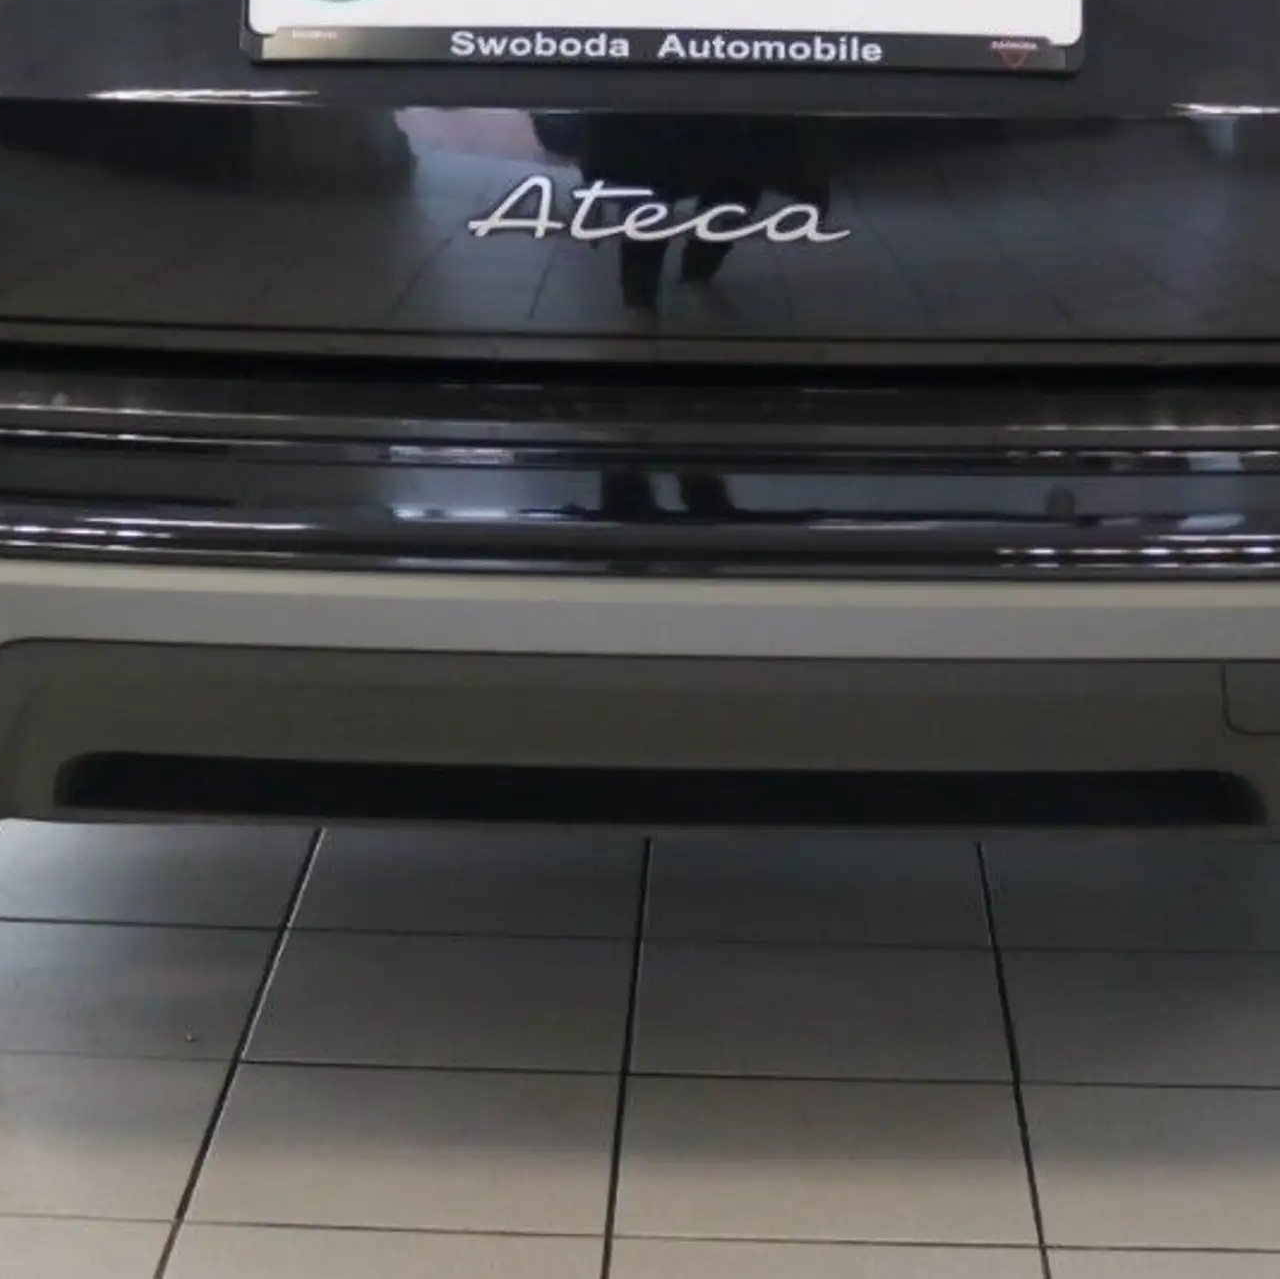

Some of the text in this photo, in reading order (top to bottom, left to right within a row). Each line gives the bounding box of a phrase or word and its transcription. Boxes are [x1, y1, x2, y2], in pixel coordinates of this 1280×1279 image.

[450, 30, 884, 63] Swoboda Automobile
[467, 174, 851, 244] Ateca
